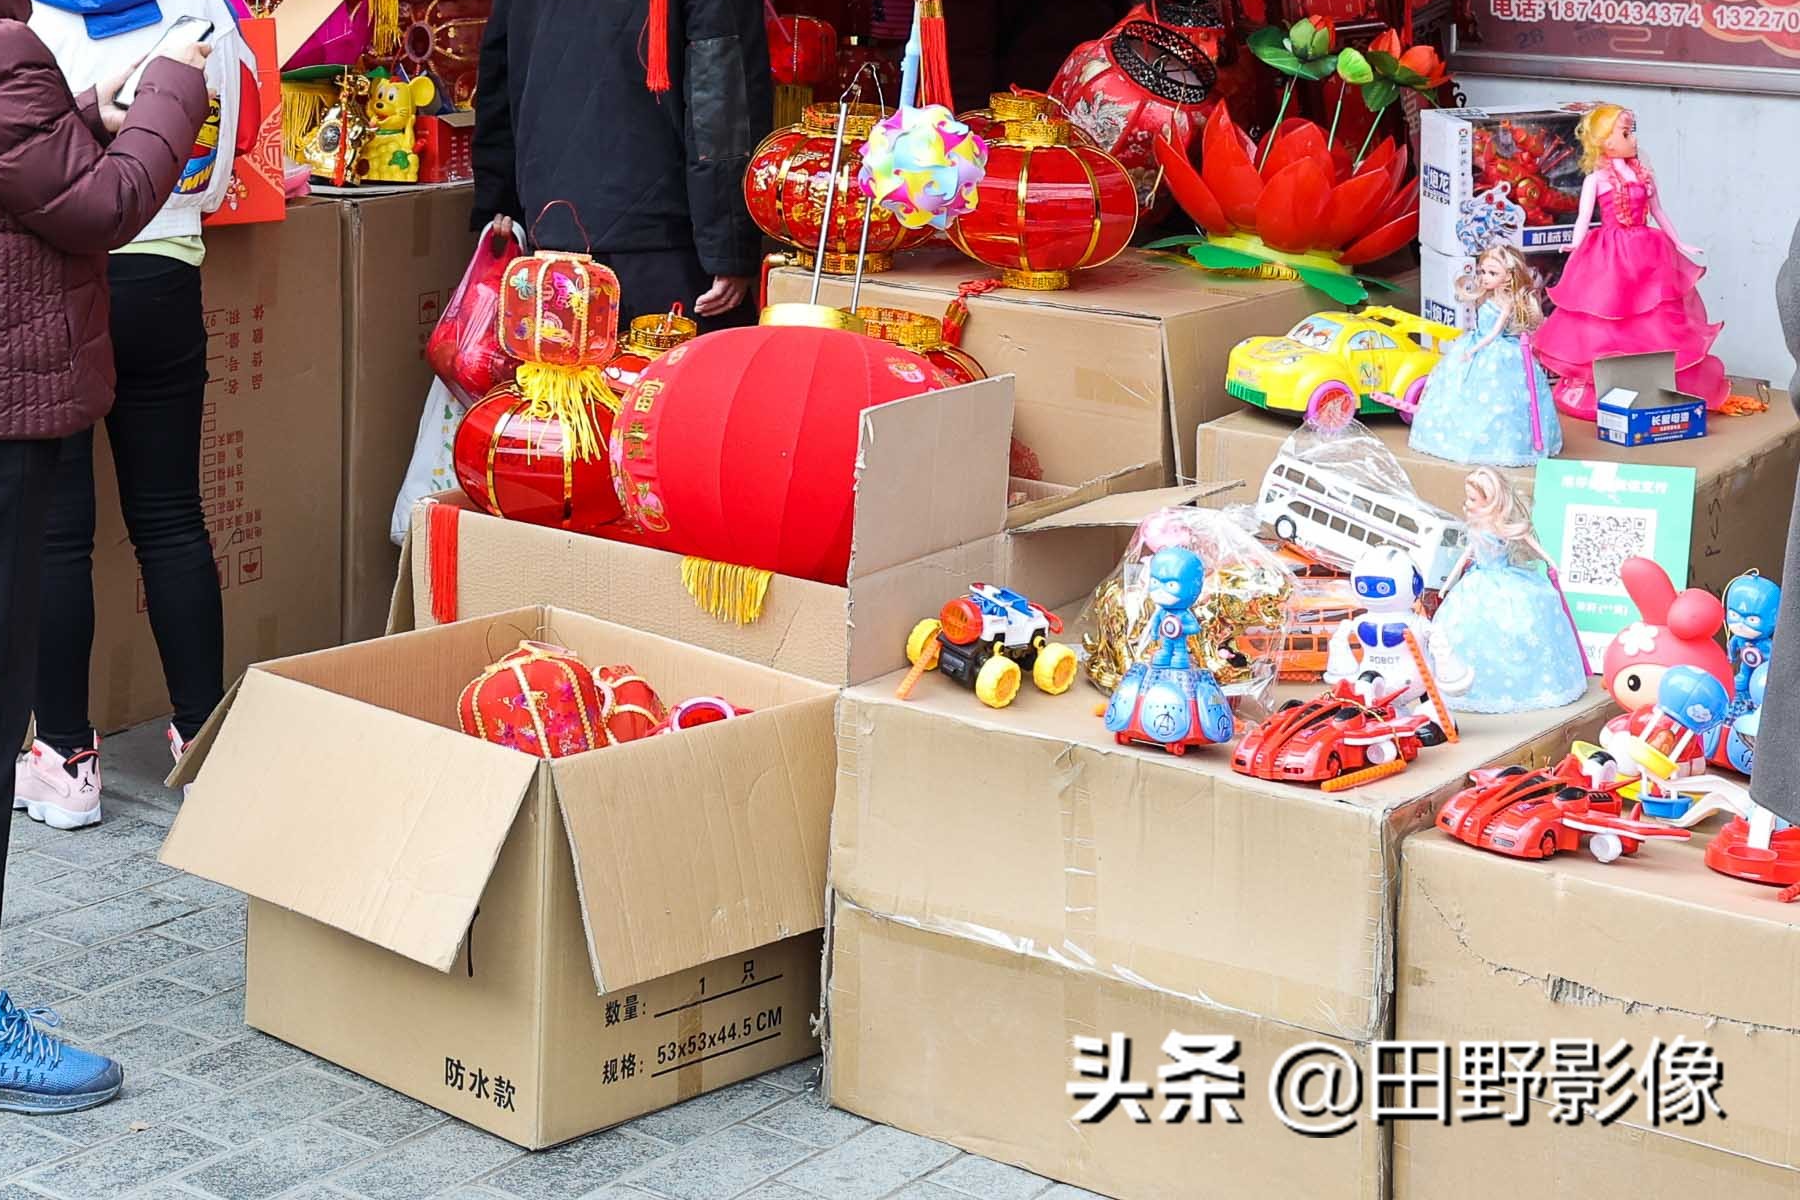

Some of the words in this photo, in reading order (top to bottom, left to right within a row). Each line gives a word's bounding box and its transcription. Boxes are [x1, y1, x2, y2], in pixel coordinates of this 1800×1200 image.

[604, 993, 648, 1028] 数量：
[699, 977, 706, 995] 1
[740, 960, 756, 984] 只
[602, 1052, 645, 1085] 规格：
[756, 1006, 783, 1032] CM
[444, 1056, 516, 1113] 防水款
